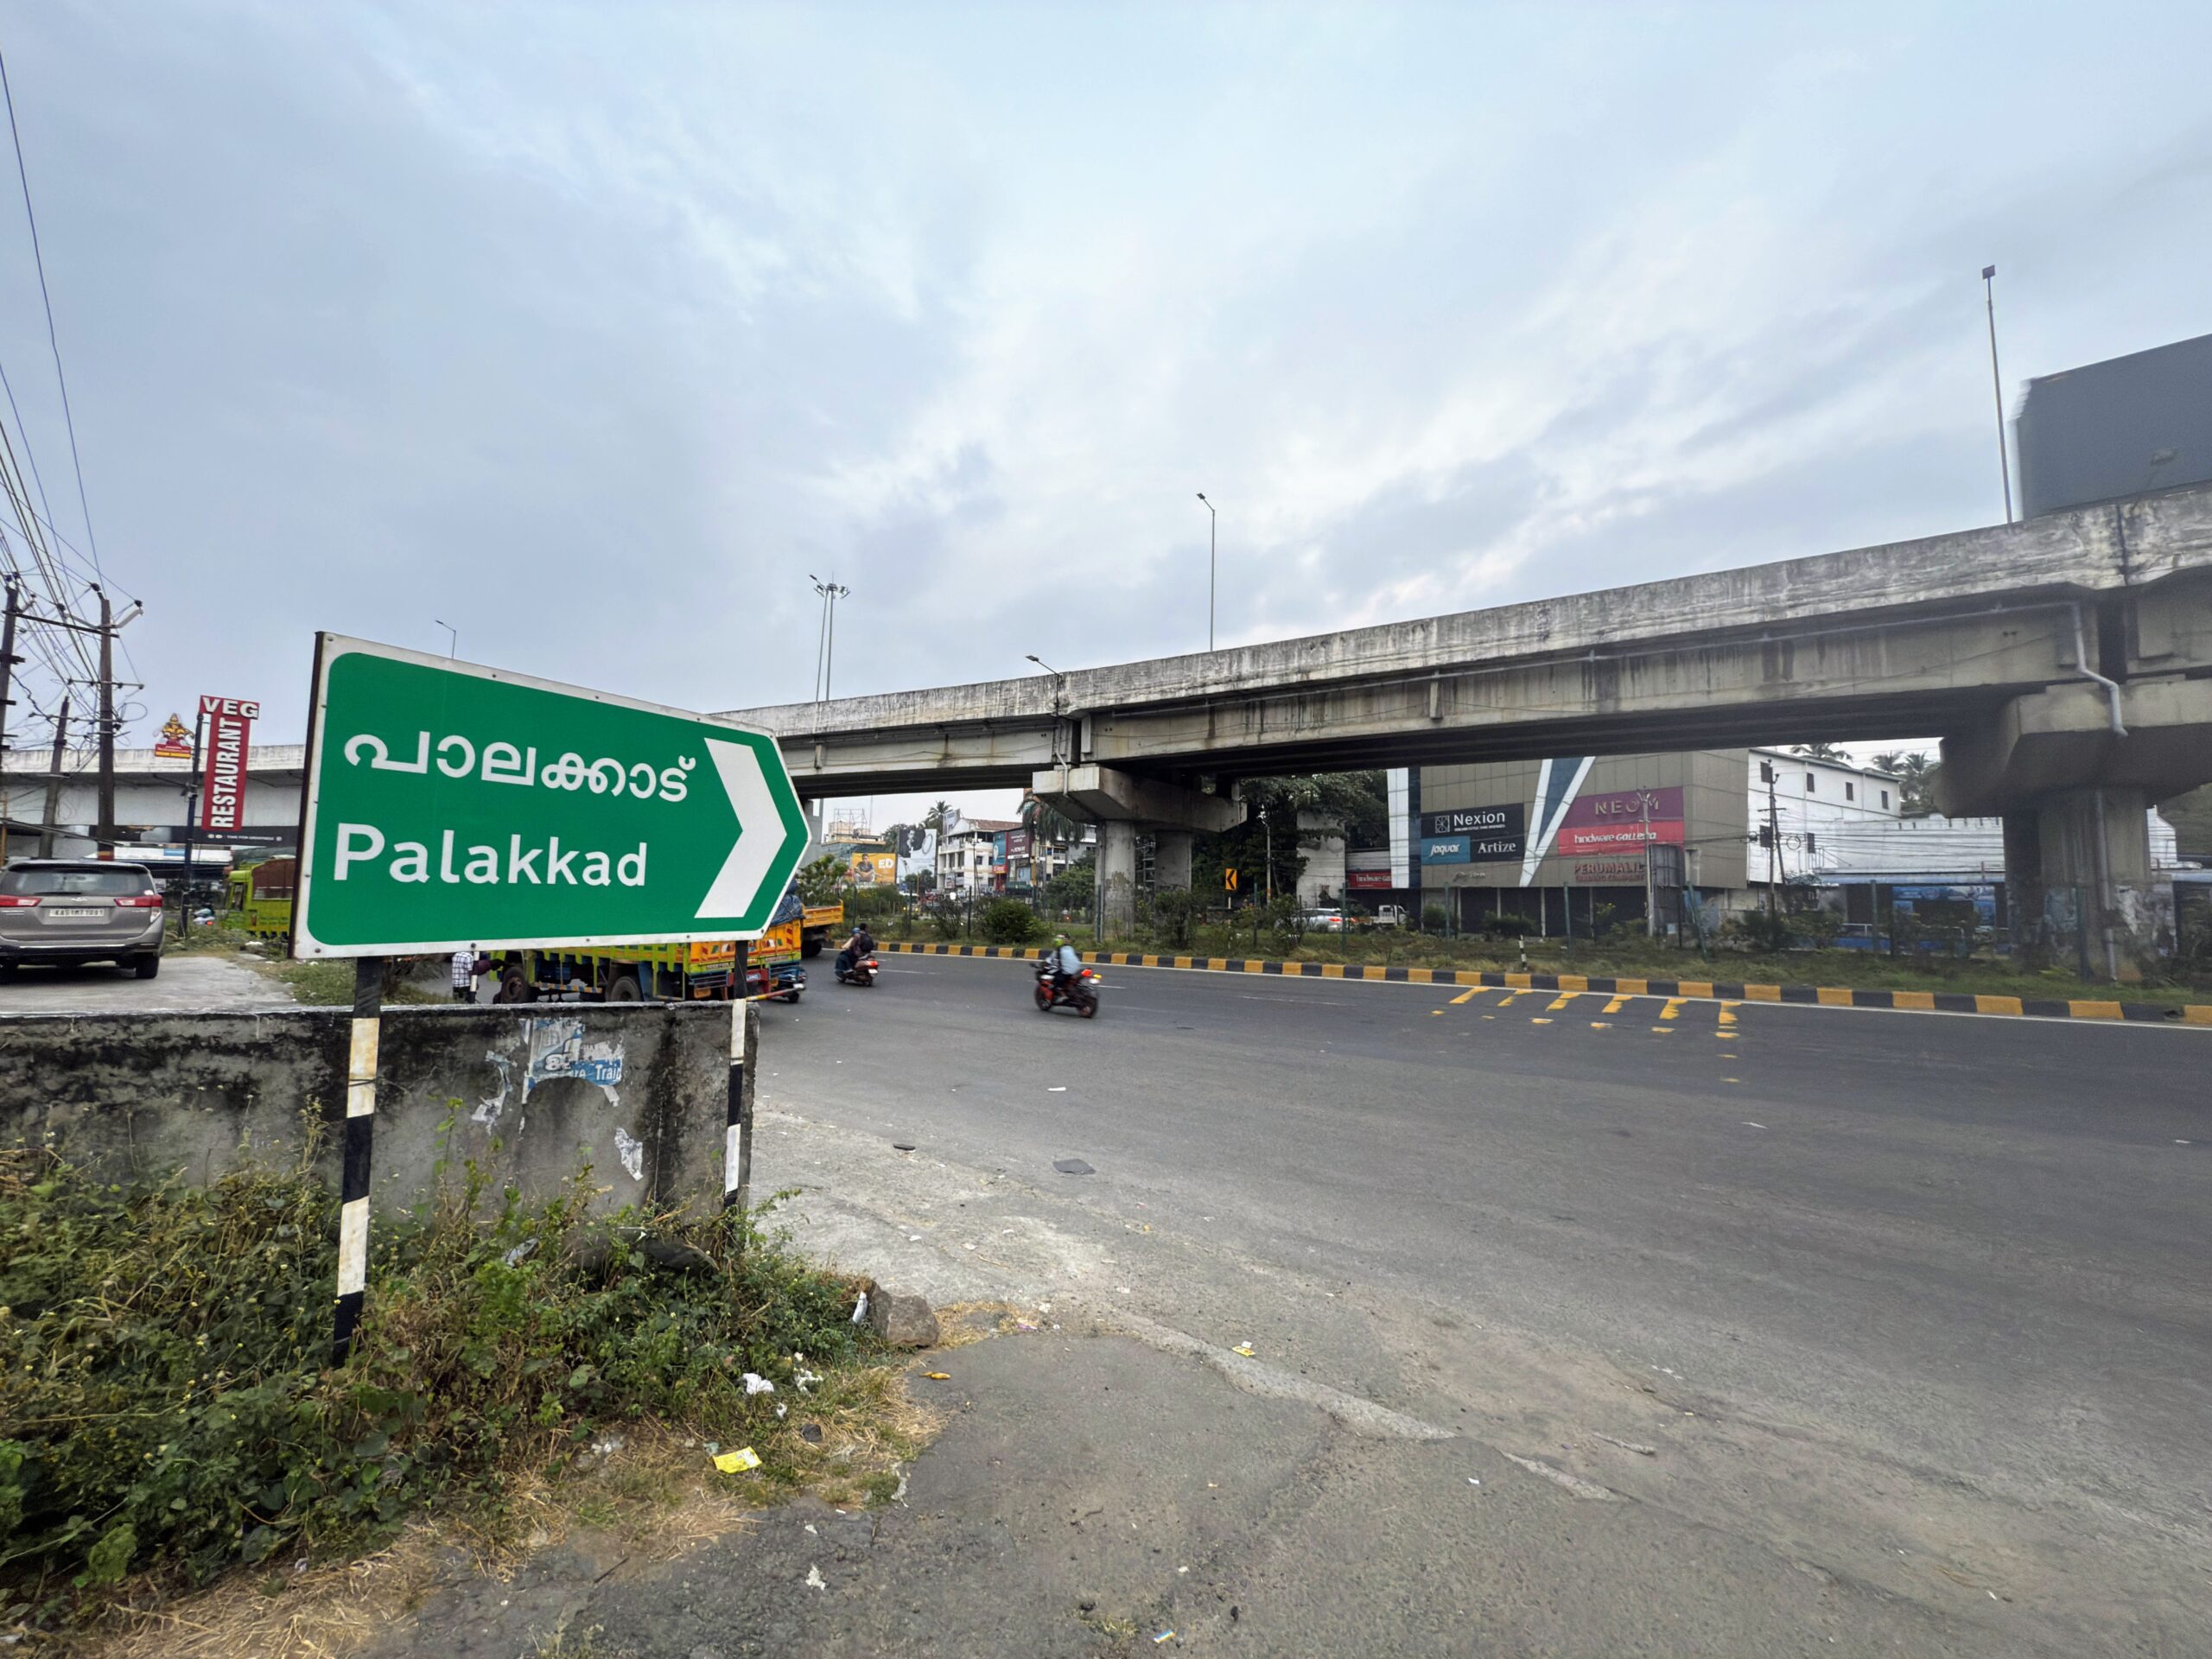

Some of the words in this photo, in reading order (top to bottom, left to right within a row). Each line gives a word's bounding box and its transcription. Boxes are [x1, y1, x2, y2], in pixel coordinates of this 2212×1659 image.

[202, 696, 259, 719] VEG
[210, 717, 243, 828] RESTAURANT
[344, 731, 696, 802] പാലക്കാട്
[1453, 811, 1505, 827] Nexion
[1478, 841, 1516, 854] Artize
[1574, 833, 1615, 843] hindware
[334, 823, 647, 887] Palakkad
